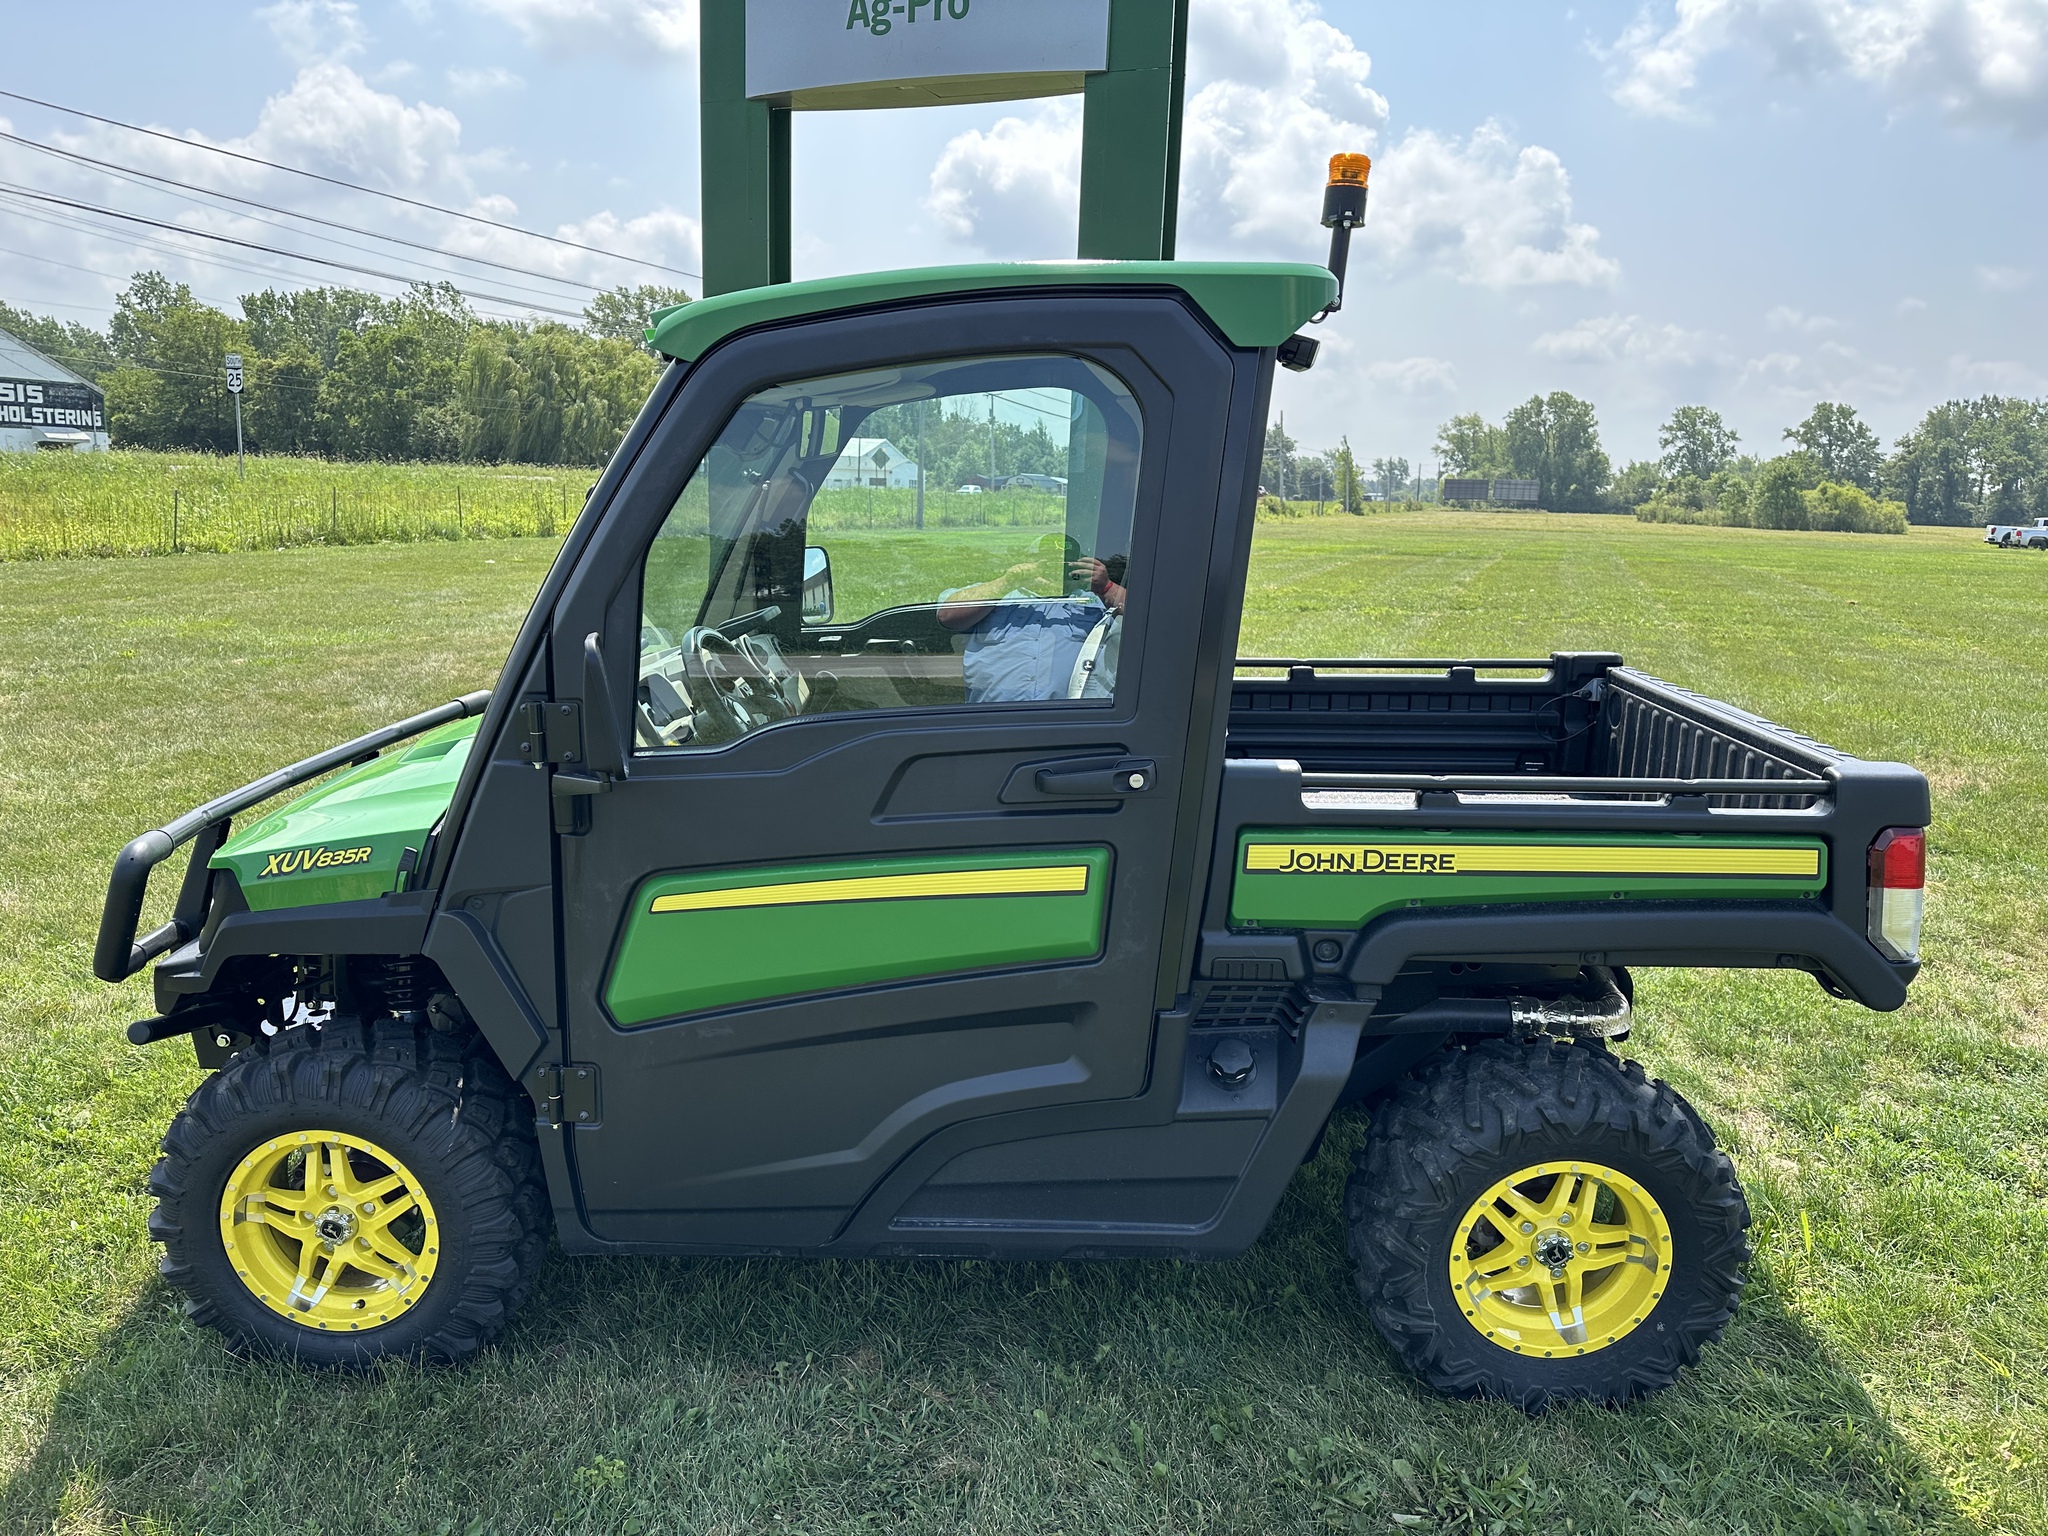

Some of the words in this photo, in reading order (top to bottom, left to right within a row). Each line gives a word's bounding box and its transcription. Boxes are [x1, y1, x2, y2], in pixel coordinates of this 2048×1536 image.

[846, 0, 970, 36] Ag-Pro
[226, 356, 242, 365] SOUTH
[228, 373, 242, 387] 25
[258, 846, 371, 878] XUV835R
[1279, 849, 1355, 871] JOHN
[1363, 849, 1456, 871] DEERE
